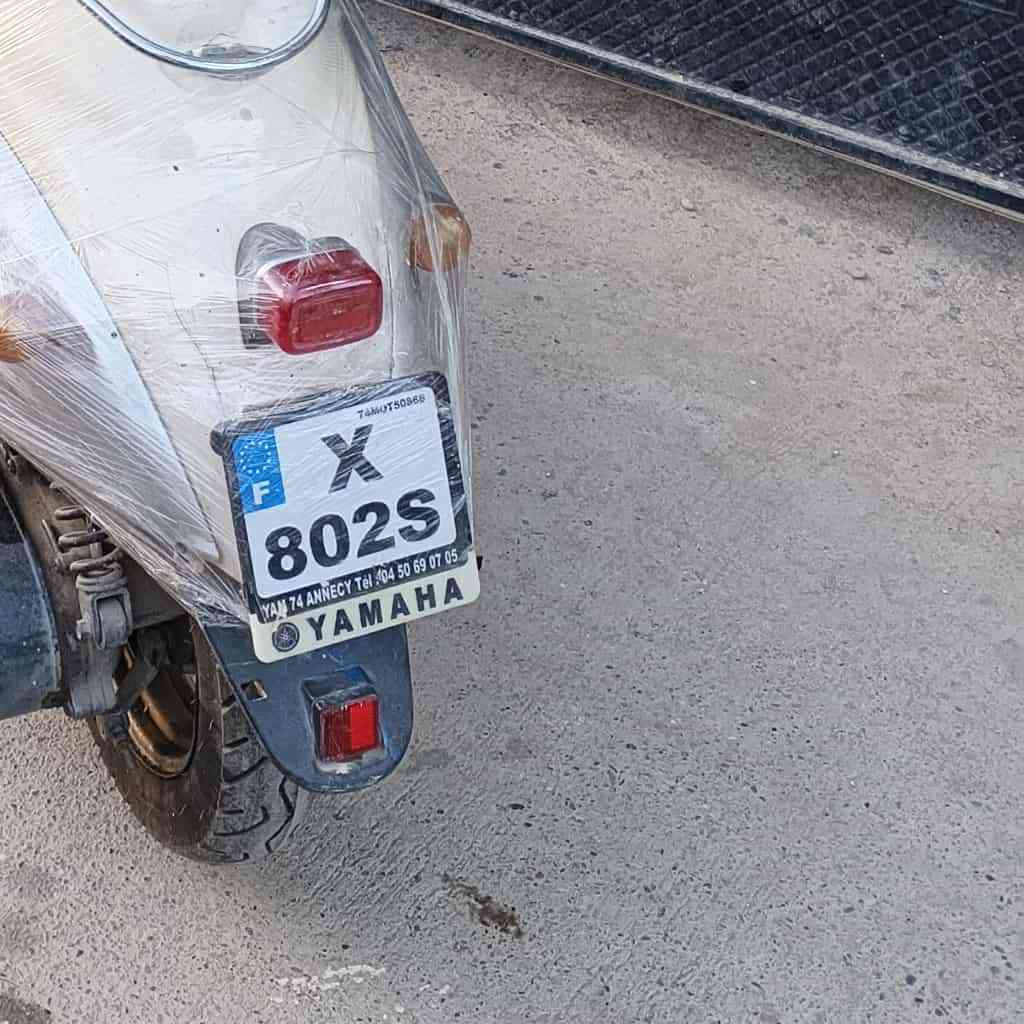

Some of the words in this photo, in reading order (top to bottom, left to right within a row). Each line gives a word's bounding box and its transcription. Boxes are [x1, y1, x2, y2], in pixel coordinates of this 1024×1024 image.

[321, 424, 384, 493] X
[252, 480, 270, 505] F
[265, 488, 441, 581] 802S
[289, 594, 303, 611] 74
[307, 580, 352, 607] ANNECY
[397, 563, 411, 579] 50
[413, 558, 427, 574] 69
[429, 553, 441, 569] 07
[445, 549, 458, 564] 05
[307, 577, 464, 641] YAMAHA
